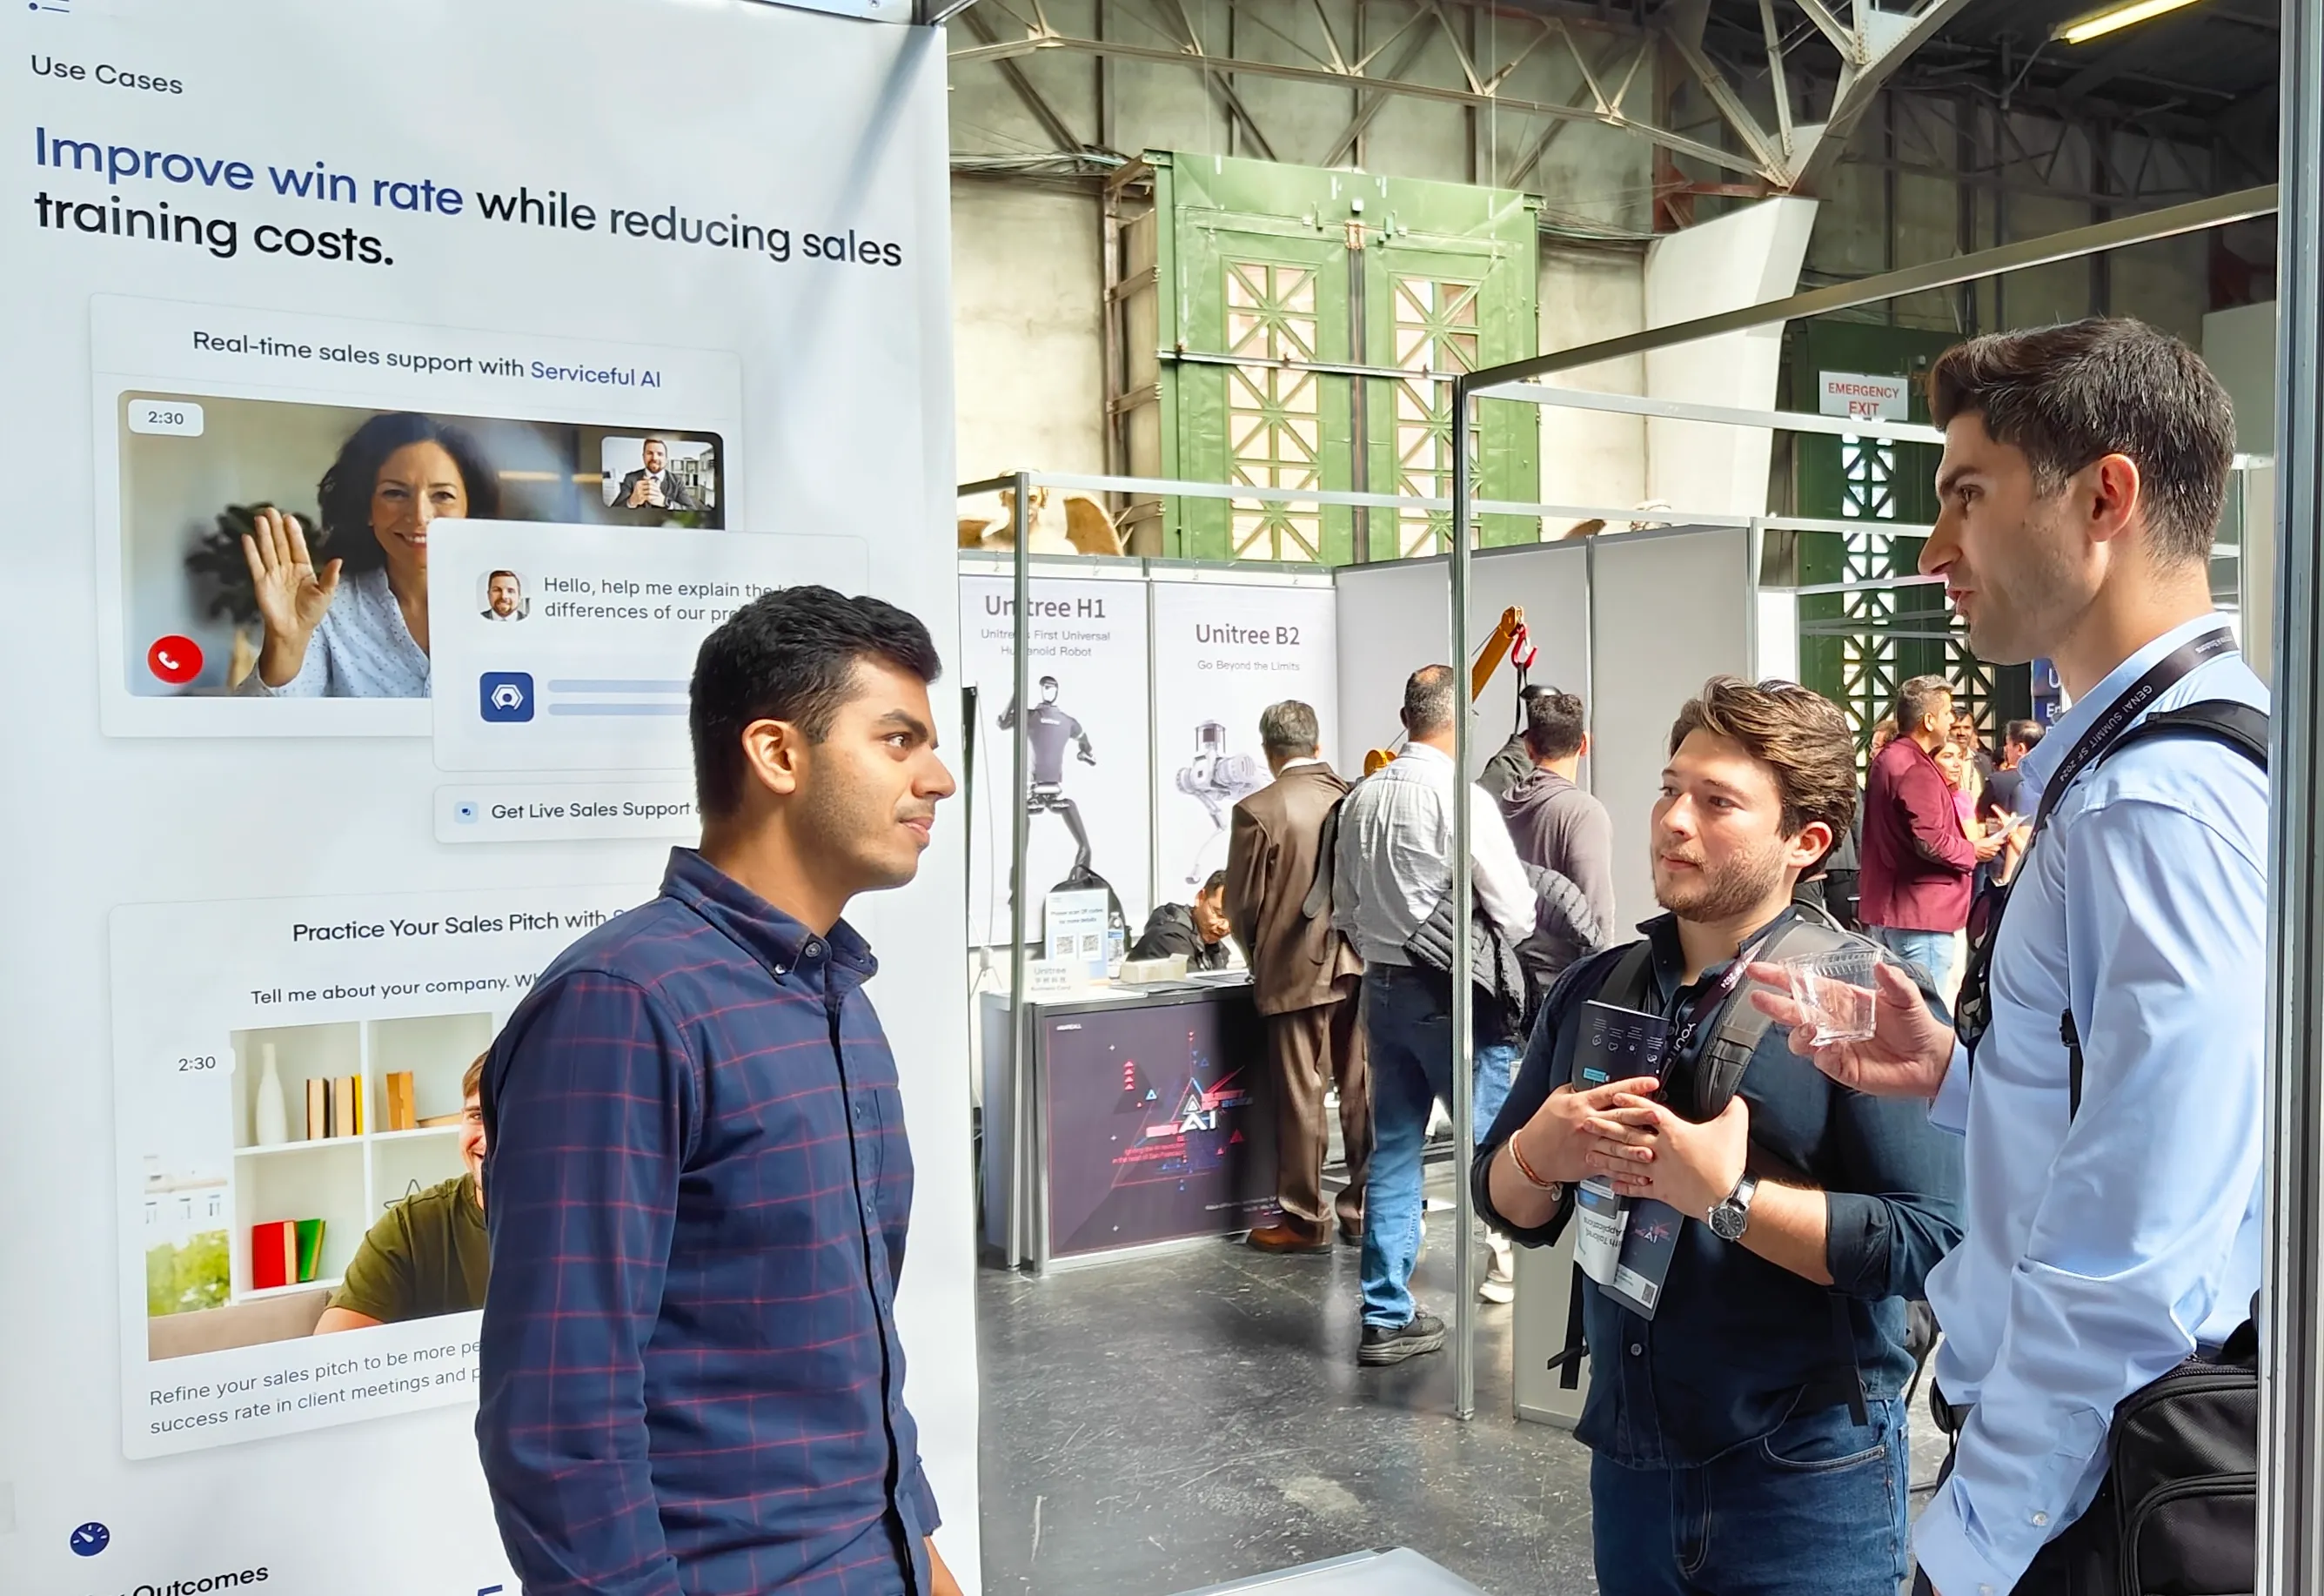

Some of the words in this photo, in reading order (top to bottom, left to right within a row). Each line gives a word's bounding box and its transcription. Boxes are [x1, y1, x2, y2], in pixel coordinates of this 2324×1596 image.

[31, 55, 86, 80] Use
[95, 64, 184, 94] Cases
[36, 127, 254, 191] Improve
[269, 162, 356, 204] win
[374, 179, 463, 215] rate
[478, 187, 596, 230] while
[610, 206, 790, 262] reducing
[802, 230, 902, 267] sales
[35, 191, 237, 258] training
[253, 226, 393, 266] costs.
[193, 331, 311, 359] Real-time
[319, 344, 379, 366] sales
[386, 352, 472, 374] support
[478, 358, 524, 378] with
[531, 361, 635, 386] Serviceful
[640, 372, 661, 387] AI
[1828, 382, 1899, 399] EMERGENCY
[148, 411, 184, 426] 2:30
[1849, 401, 1879, 416] EXIT
[545, 577, 596, 597] Hello,
[602, 579, 640, 597] help
[646, 582, 673, 596] me
[678, 581, 740, 599] explain
[545, 602, 648, 619] differences
[653, 604, 673, 620] of
[676, 607, 706, 620] our
[712, 608, 738, 623] pro
[986, 595, 1071, 617] Untree
[1078, 599, 1106, 618] H1
[1035, 630, 1058, 640] First
[1062, 631, 1110, 641] Universal
[1196, 623, 1270, 645] Unitree
[1276, 626, 1301, 646] B2
[1001, 646, 1055, 656] Huanoid
[1061, 647, 1092, 657] Robot
[1197, 660, 1213, 671] Go
[1216, 661, 1251, 673] Beyond
[1254, 661, 1269, 671] the
[1271, 661, 1301, 672] Limits
[2122, 685, 2153, 714] GENAI
[2090, 713, 2123, 748] SUMMIT
[2077, 748, 2090, 761] SF
[2059, 760, 2077, 782] 2024
[492, 803, 524, 820] Get
[529, 803, 565, 819] Live
[571, 802, 618, 818] Sales
[623, 801, 690, 820] Support
[293, 922, 385, 942] Practice
[391, 919, 439, 937] Your
[445, 915, 503, 935] Sales
[510, 912, 559, 931] Pitch
[565, 909, 606, 929] with
[251, 989, 282, 1006] Tell
[287, 989, 318, 1003] me
[323, 983, 376, 1001] about
[381, 984, 420, 1001] your
[425, 976, 510, 995] company.
[178, 1056, 216, 1072] 2:30
[150, 1383, 211, 1407] Refine
[216, 1376, 258, 1400] your
[263, 1367, 310, 1389] sales
[315, 1358, 358, 1382] pitch
[364, 1354, 382, 1371] to
[386, 1348, 408, 1366] be
[413, 1345, 456, 1362] more
[150, 1410, 229, 1435] success
[234, 1400, 271, 1422] rate
[276, 1397, 292, 1414] in
[298, 1387, 346, 1410] client
[352, 1375, 430, 1401] meetings
[435, 1367, 465, 1385] and
[132, 1566, 269, 1596] Outcomes
